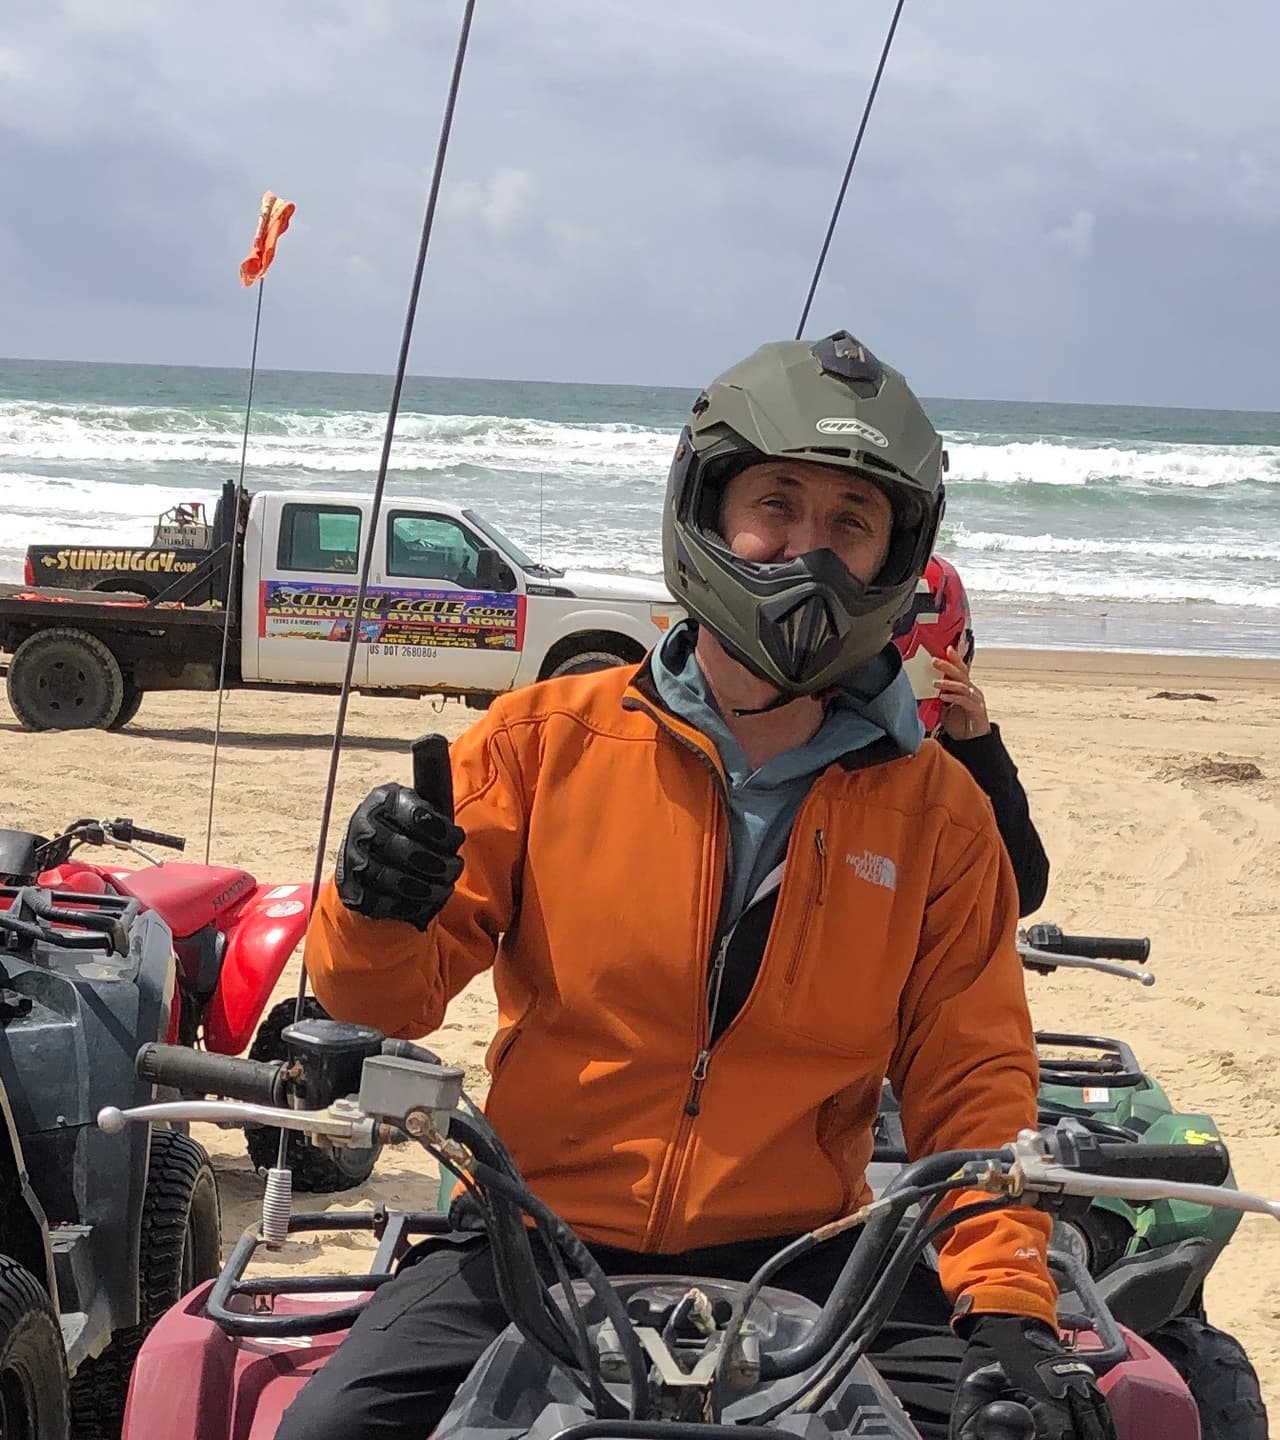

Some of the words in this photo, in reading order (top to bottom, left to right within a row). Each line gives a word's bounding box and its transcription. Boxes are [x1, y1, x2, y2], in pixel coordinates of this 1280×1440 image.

[267, 607, 381, 620] ADVENTURE
[387, 612, 461, 624] STARTS
[466, 616, 516, 627] NOW!
[369, 645, 380, 654] US
[383, 645, 399, 656] DOT
